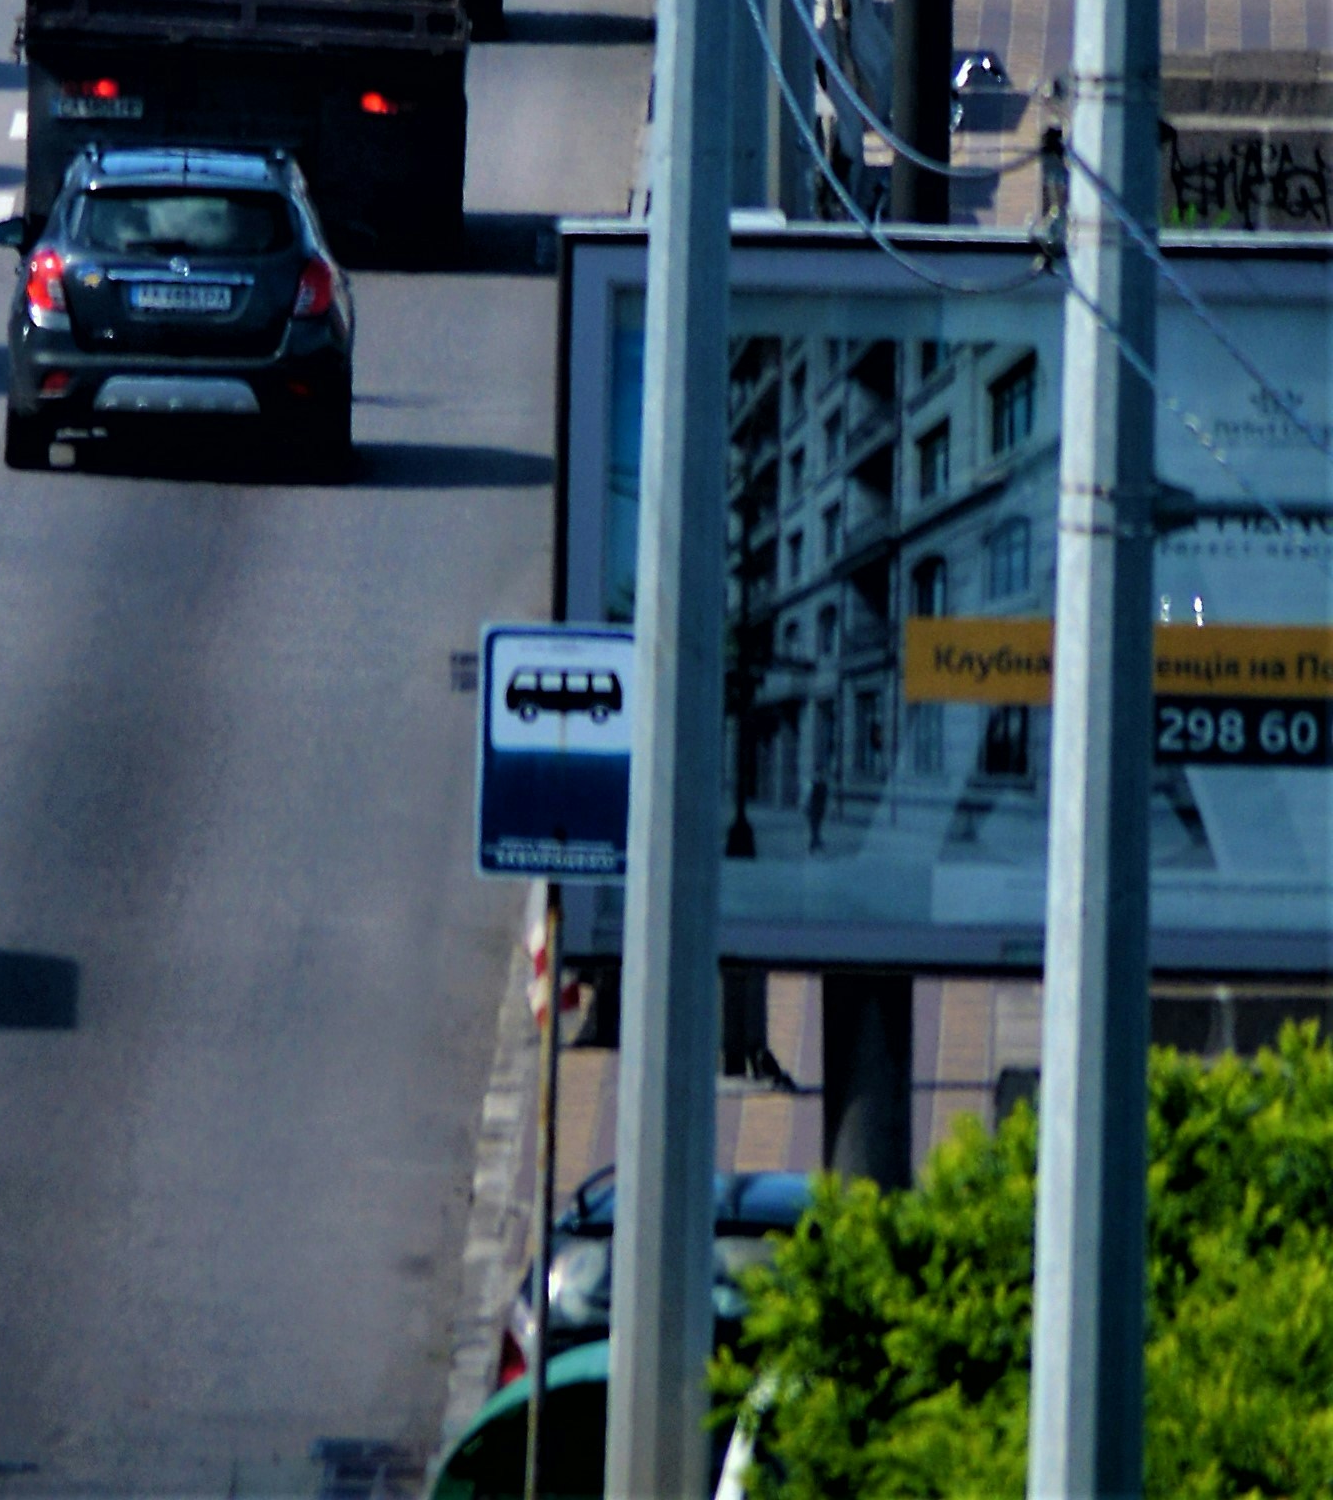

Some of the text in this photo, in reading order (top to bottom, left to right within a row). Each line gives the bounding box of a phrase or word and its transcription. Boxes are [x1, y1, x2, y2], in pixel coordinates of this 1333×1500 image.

[935, 643, 1052, 684] Клубна
[1249, 656, 1286, 678] на
[1158, 707, 1319, 754] 298 60
